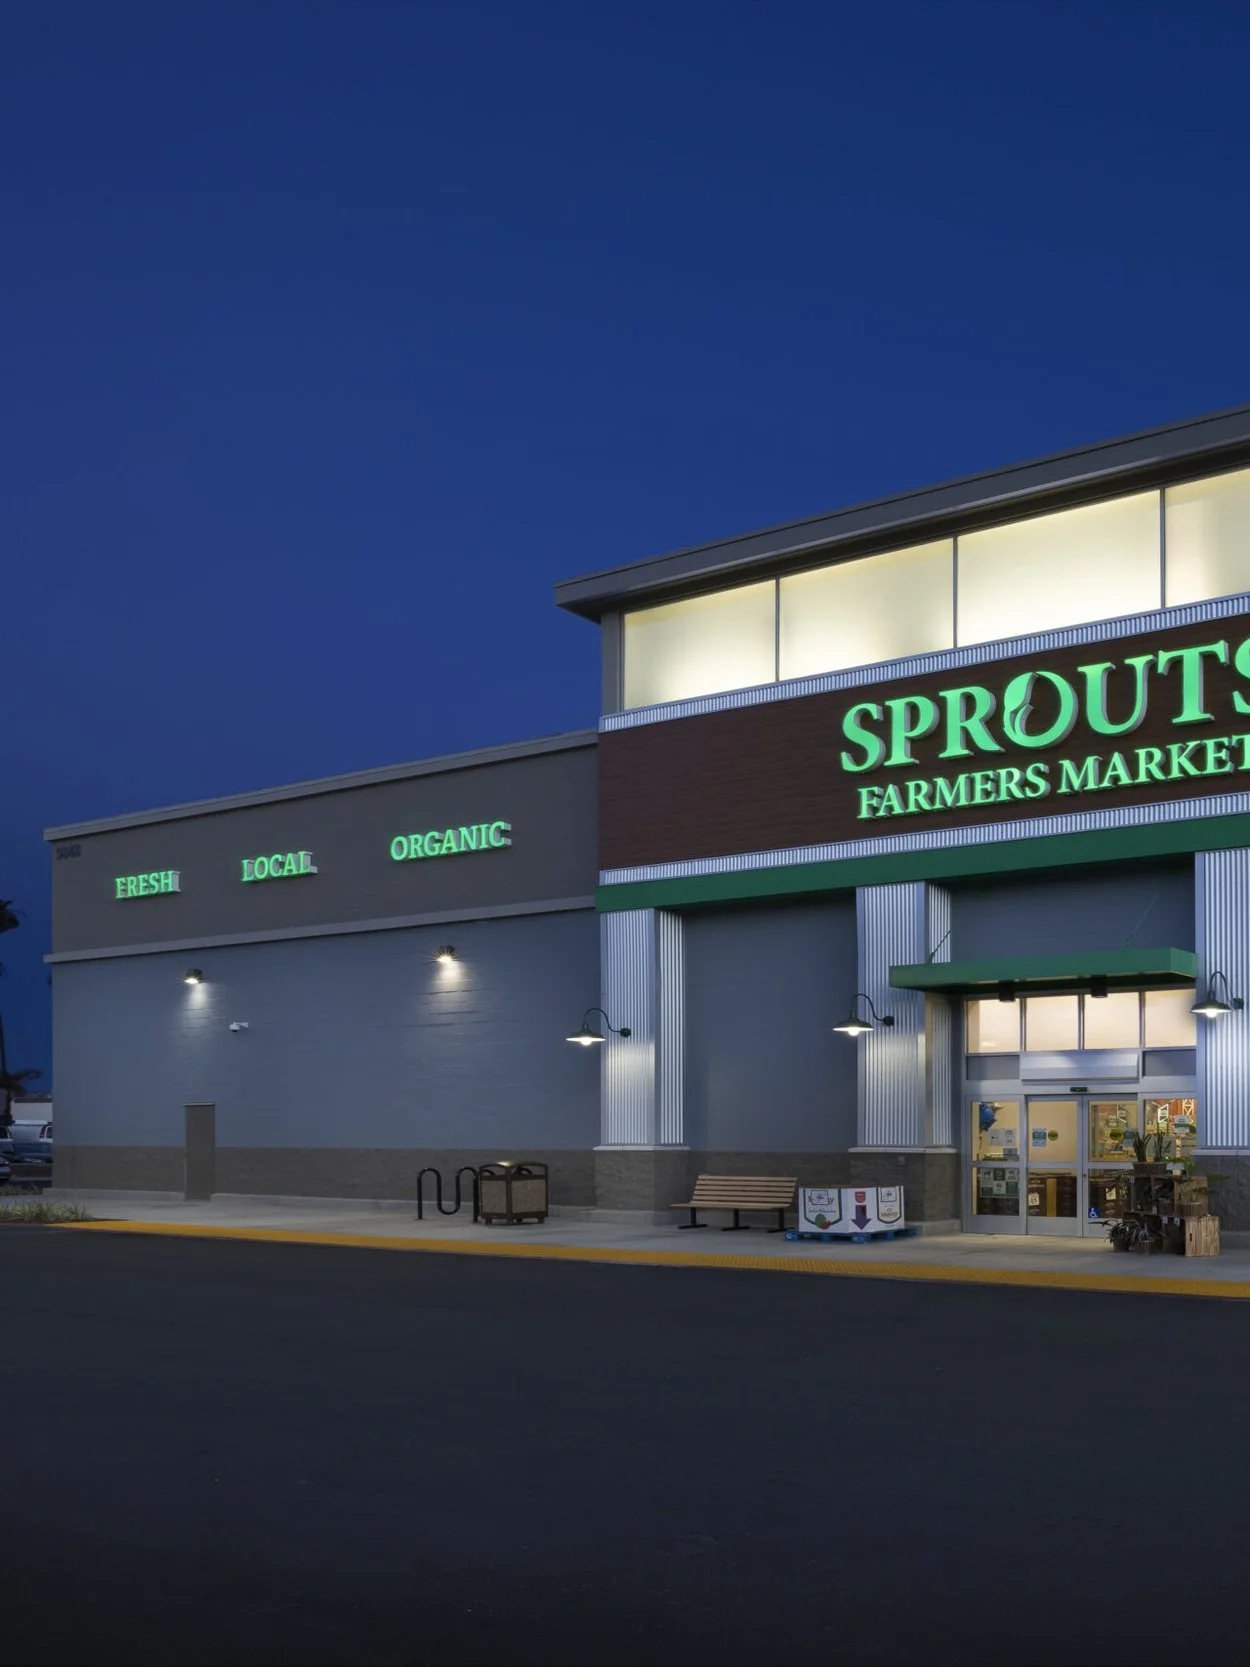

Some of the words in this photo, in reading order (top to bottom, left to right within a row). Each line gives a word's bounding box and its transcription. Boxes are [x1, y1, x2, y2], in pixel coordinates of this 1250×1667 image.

[857, 763, 1048, 819] FARMERS
[390, 821, 510, 861] ORGANIC
[241, 851, 316, 882] LOCAL
[115, 870, 179, 899] FRESH
